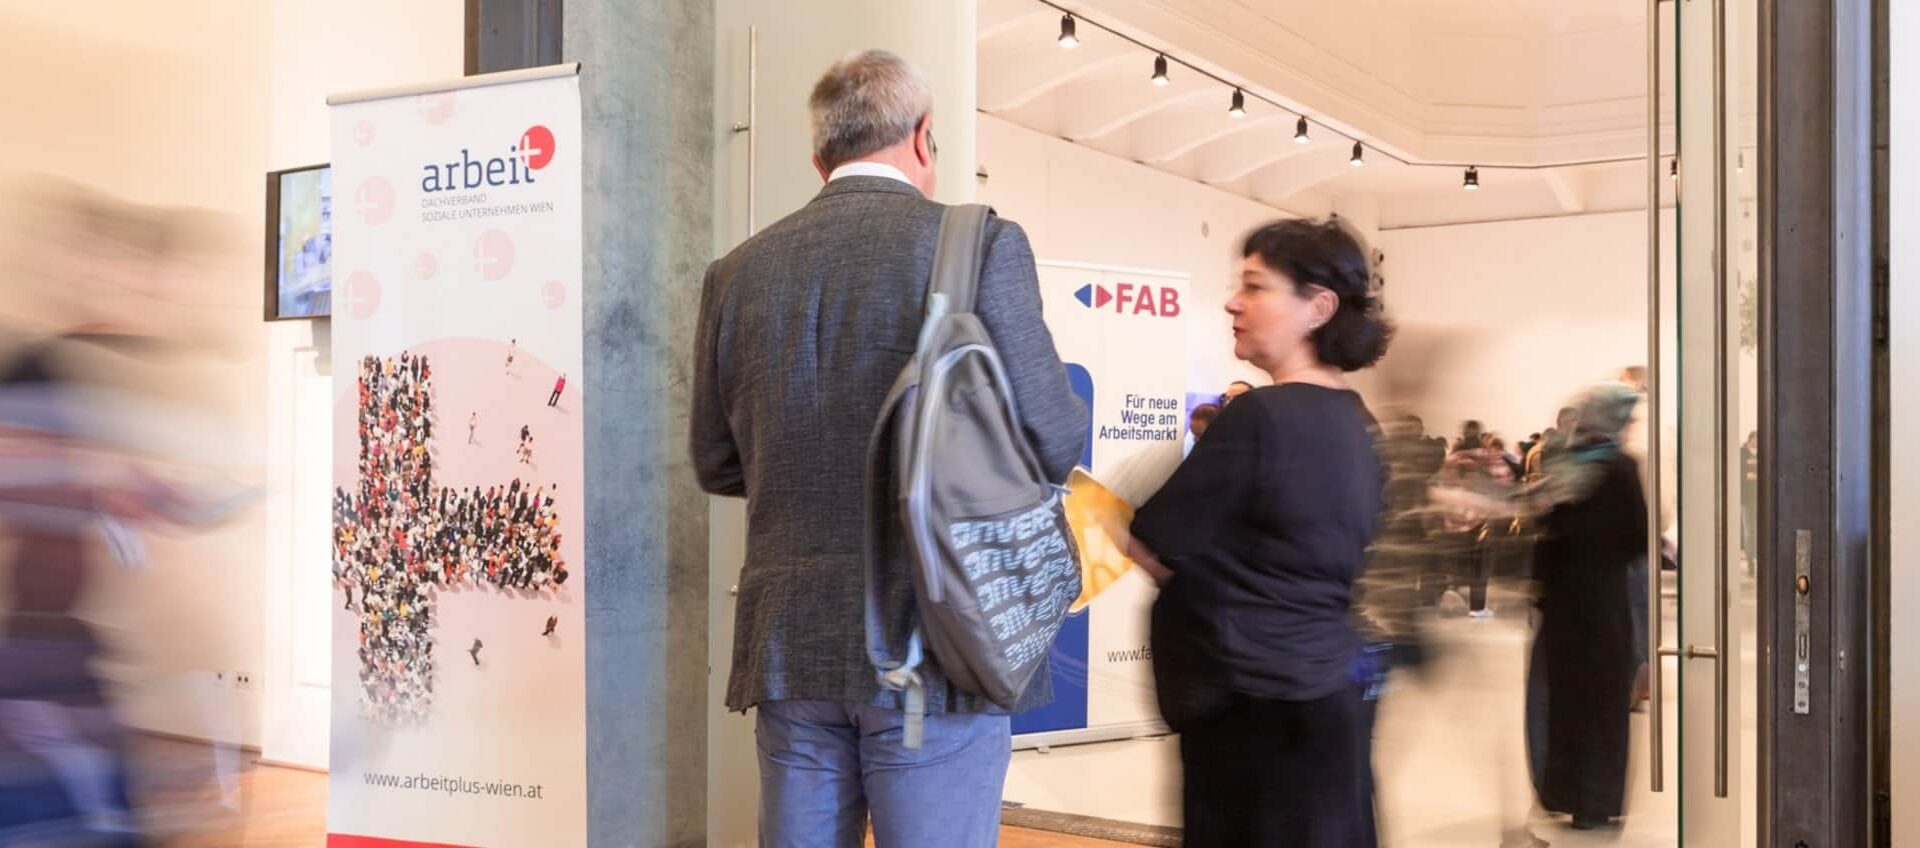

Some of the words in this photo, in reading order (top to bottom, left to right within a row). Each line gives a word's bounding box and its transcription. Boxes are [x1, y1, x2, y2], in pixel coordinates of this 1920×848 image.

[421, 193, 487, 209] DACHVERBAND
[421, 207, 458, 223] SOZIALE
[459, 203, 528, 219] UNTERNEHMEN
[529, 201, 554, 214] WIEN
[1115, 282, 1181, 318] FAB
[1125, 393, 1145, 409] Für
[1148, 396, 1178, 410] neue
[1121, 410, 1155, 427] Wege
[1158, 413, 1178, 426] am
[1099, 425, 1178, 441] Arbeitsmarkt
[364, 772, 545, 801] www.arbeitplus-wien.at
